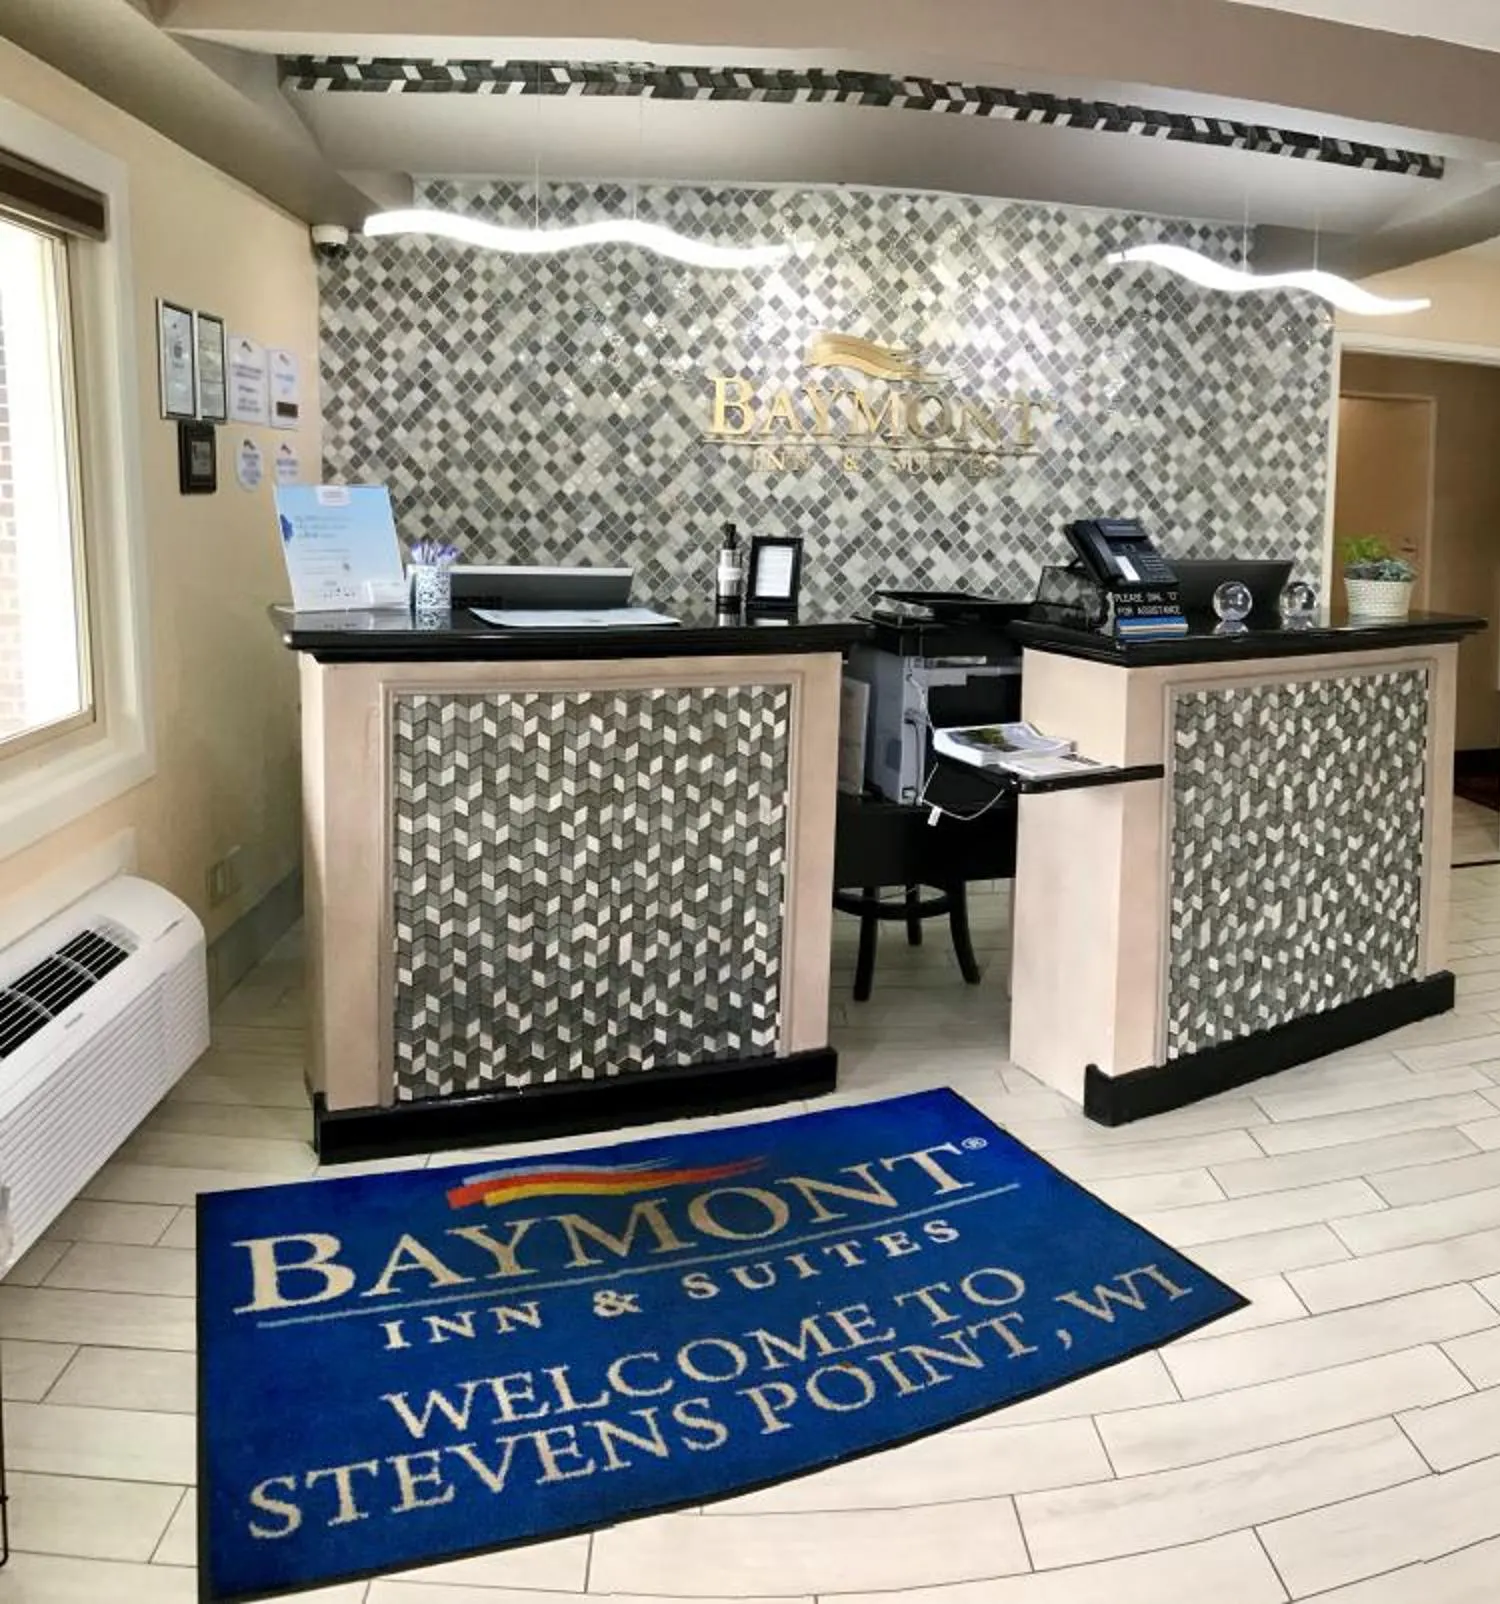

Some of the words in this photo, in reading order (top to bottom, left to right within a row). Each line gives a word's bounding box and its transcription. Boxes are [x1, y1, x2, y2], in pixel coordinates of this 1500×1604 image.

[706, 375, 1057, 446] BAYMONT
[379, 1302, 897, 1440] WELCOME
[893, 1266, 1026, 1327] TO
[381, 1301, 543, 1350] INN
[592, 1289, 644, 1318] &
[681, 1218, 961, 1299] SUITES
[247, 1396, 730, 1541] STEVENS
[1055, 1263, 1194, 1324] WI
